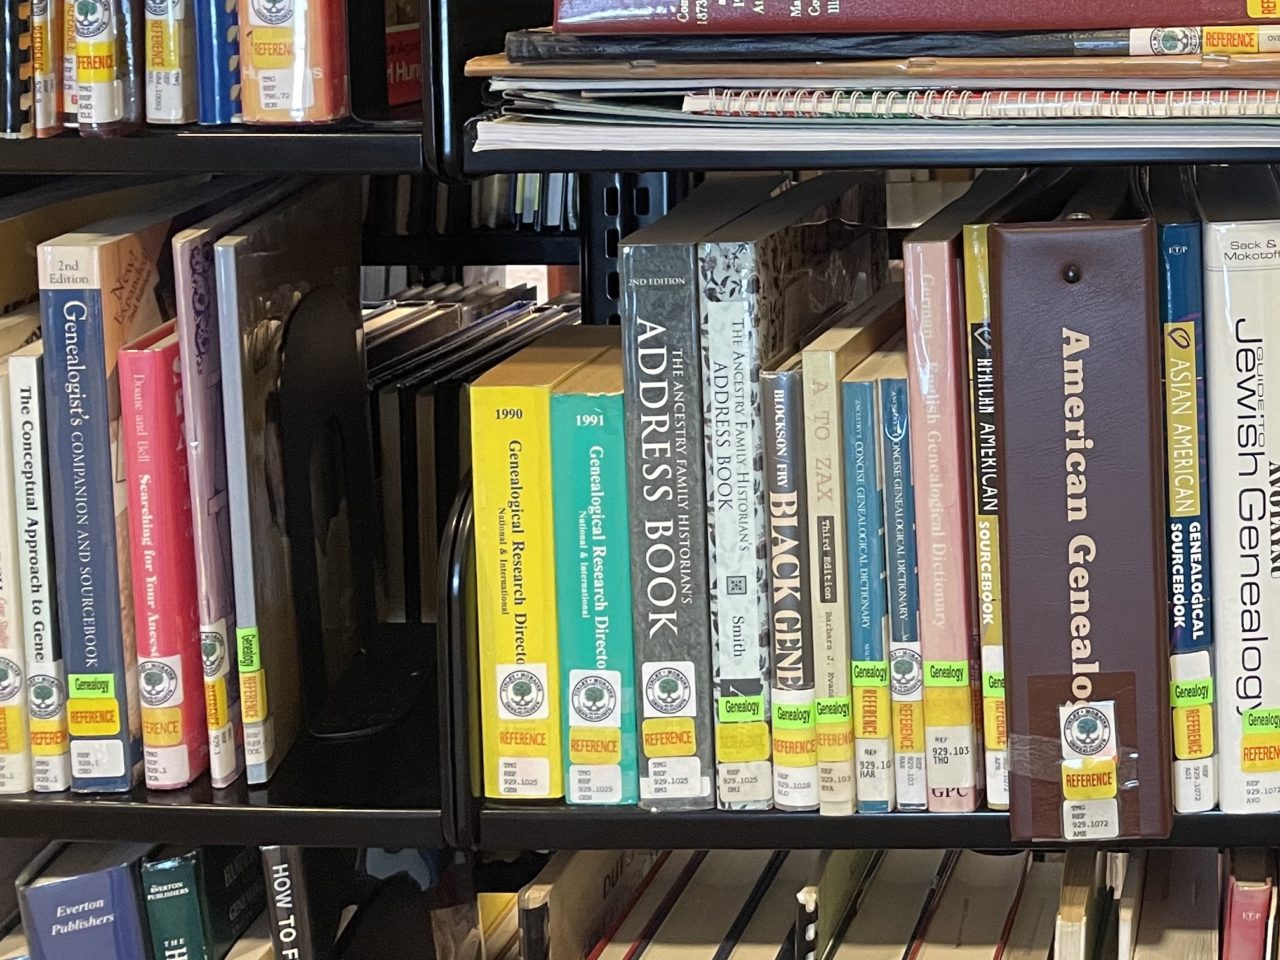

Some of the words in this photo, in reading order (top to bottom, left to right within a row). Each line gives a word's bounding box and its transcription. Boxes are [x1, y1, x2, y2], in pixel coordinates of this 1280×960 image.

[58, 260, 79, 272] 2nd
[1230, 241, 1262, 250] Sack
[1266, 239, 1277, 248] &
[49, 273, 89, 284] Edition
[628, 277, 647, 287] 2ND
[649, 277, 686, 285] EDITION
[63, 300, 90, 426] Genealogist's
[1170, 358, 1192, 415] ASIAN
[20, 387, 31, 416] The
[495, 408, 523, 419] 1990
[575, 414, 605, 426] 1991
[636, 317, 673, 502] ADDRESS
[713, 362, 731, 448] ADDRESS
[1063, 327, 1094, 522] American
[1234, 318, 1265, 478] Jewish
[21, 420, 38, 510] Conceptual
[71, 432, 89, 526] COMPANION
[508, 440, 525, 536] Genealogical
[717, 456, 733, 511] BOOK
[1172, 423, 1195, 512] AMERICAN
[24, 516, 43, 594] Approach
[77, 529, 91, 562] AND
[822, 519, 834, 550] Third
[512, 541, 527, 605] Research
[645, 521, 678, 640] BOOK
[823, 553, 836, 600] Edition
[979, 521, 994, 624] SOURCEBOOK
[1171, 523, 1185, 628] SOURCEBOOK
[1189, 522, 1204, 640] GENEALOGICAL
[31, 599, 43, 616] to
[79, 567, 98, 668] SOURCEBOOK
[732, 615, 745, 657] Smith
[56, 898, 104, 918] Everton
[272, 863, 293, 909] HOW
[51, 912, 114, 936] Publishers
[277, 914, 297, 943] TO
